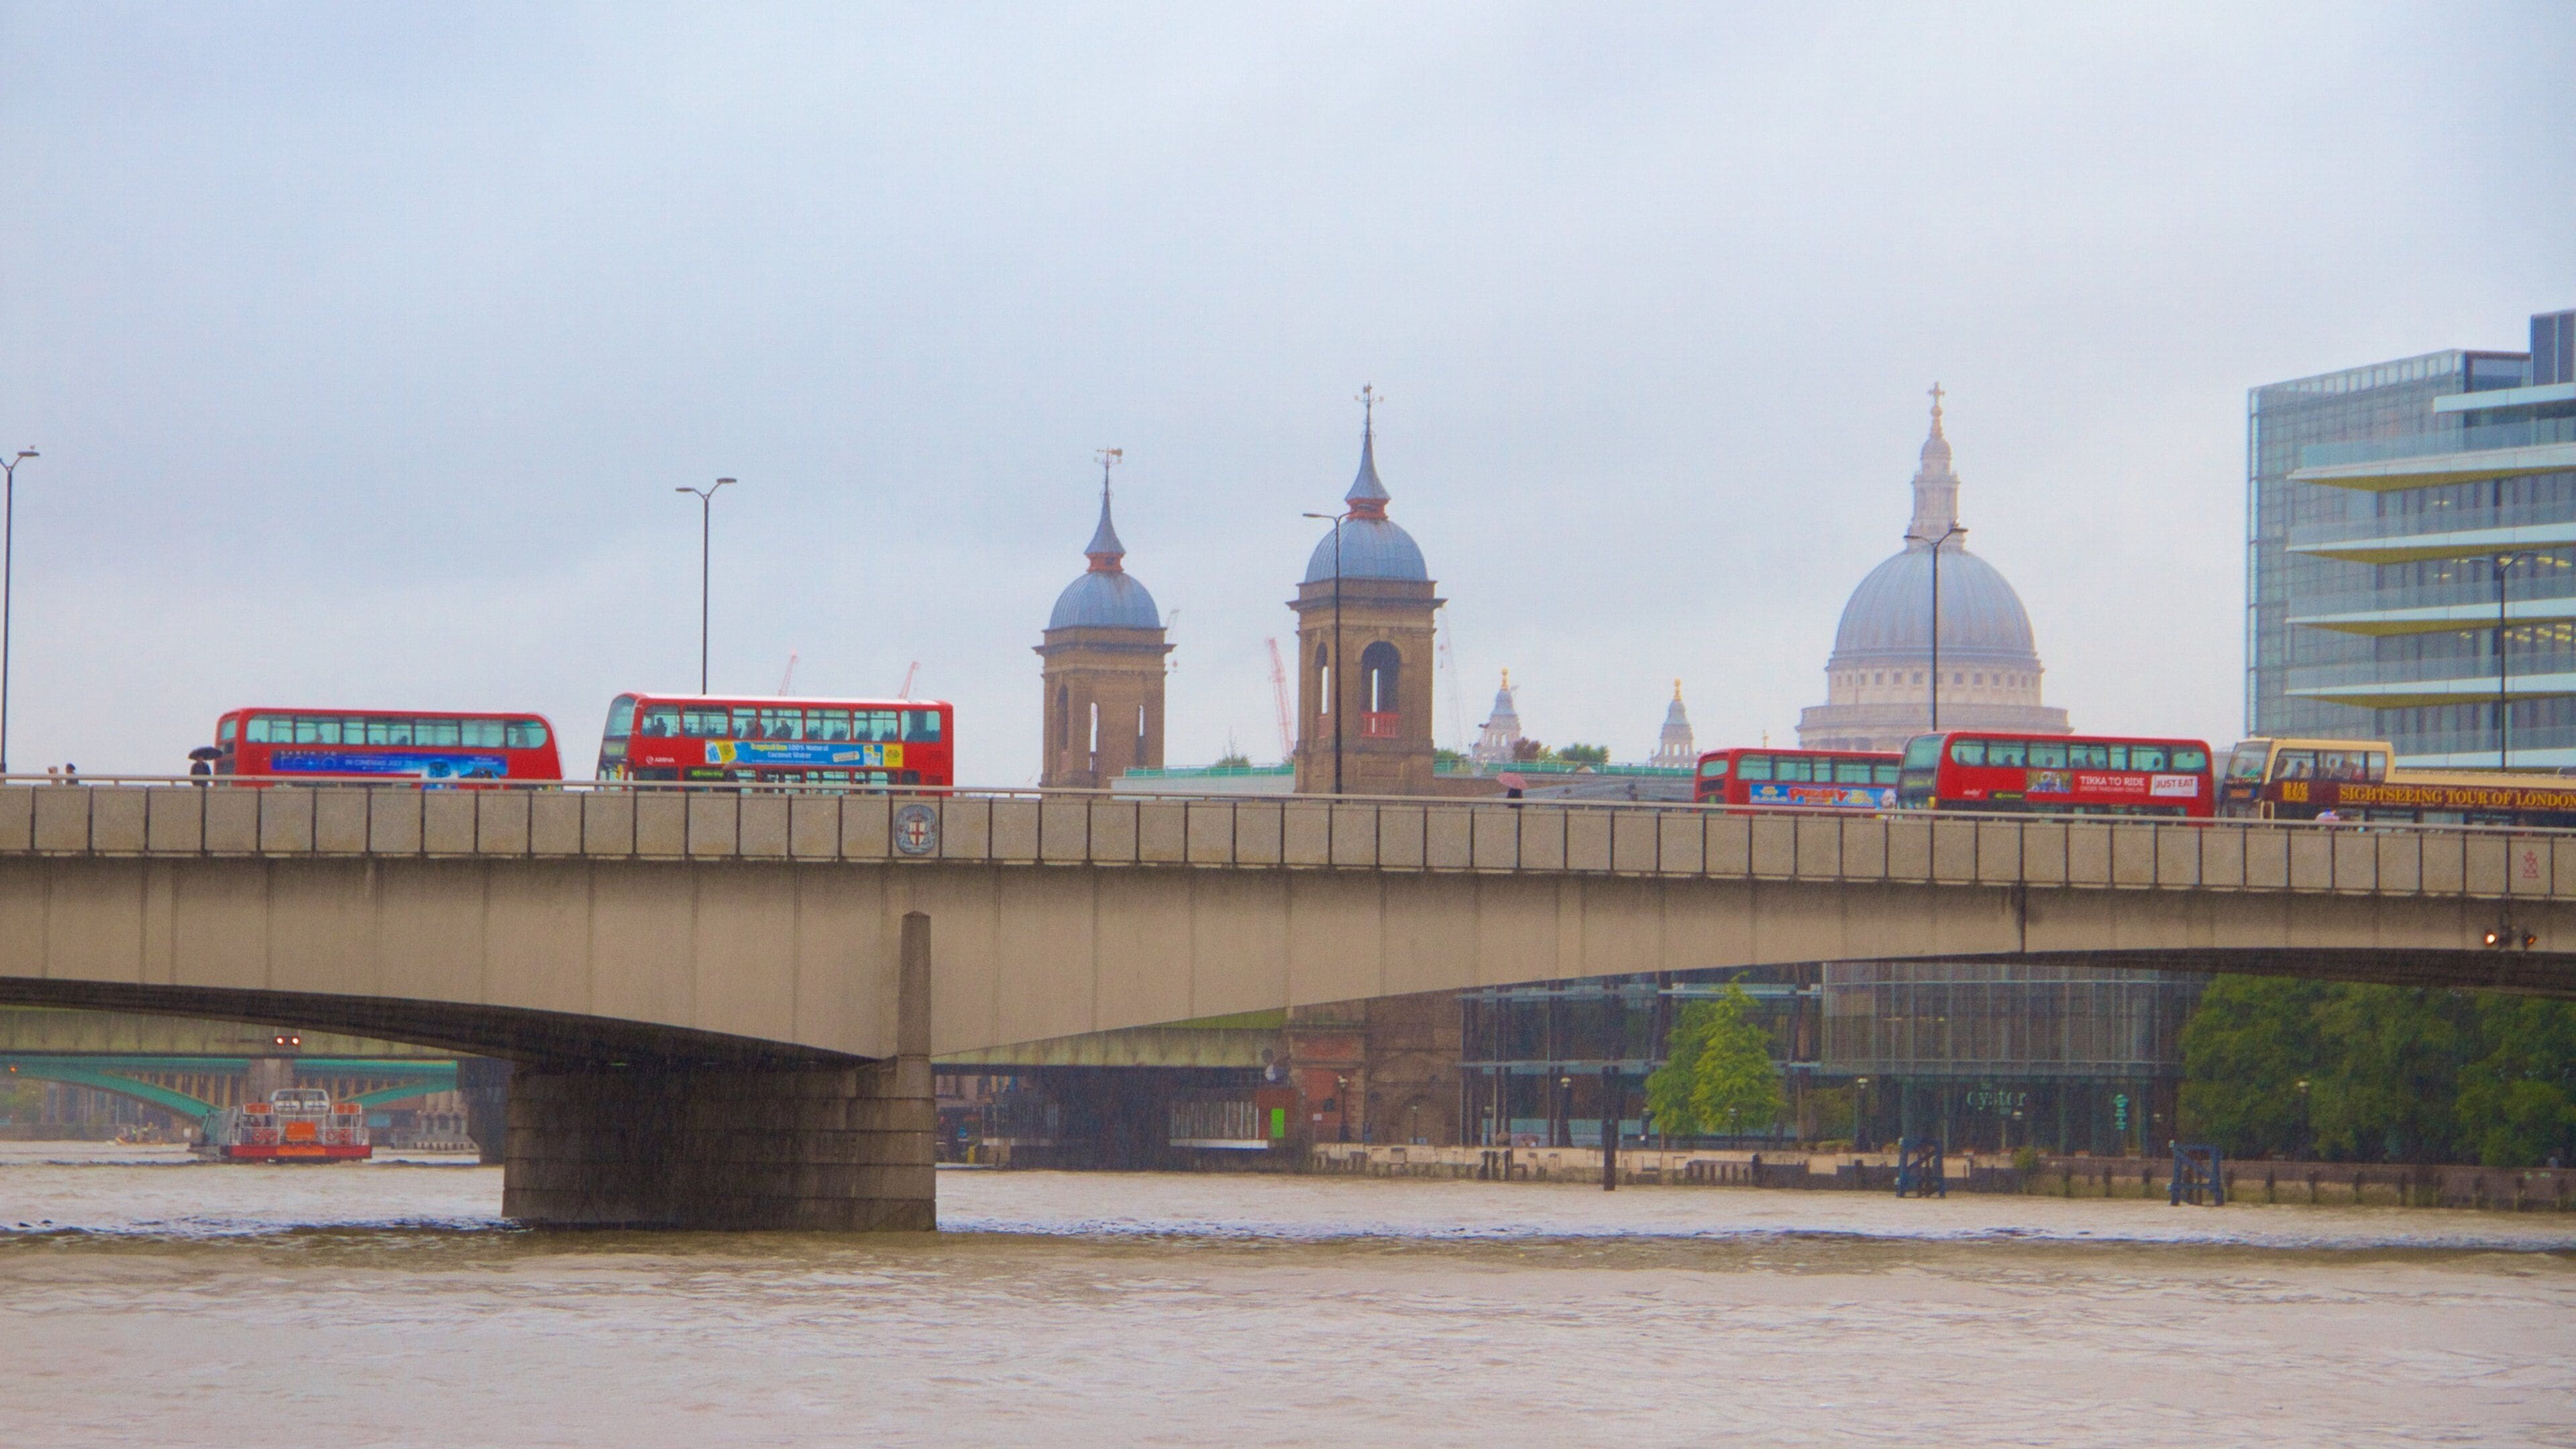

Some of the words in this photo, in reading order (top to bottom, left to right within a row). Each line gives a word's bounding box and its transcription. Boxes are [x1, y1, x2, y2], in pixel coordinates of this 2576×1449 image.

[2080, 775, 2107, 786] TIKKA
[2108, 776, 2123, 786] TO
[2124, 777, 2145, 786] RIDE
[2155, 780, 2176, 788] JUST
[2178, 779, 2194, 787] EAT
[2339, 786, 2443, 802] SIGHTSEEING
[2446, 790, 2488, 805] TOUR
[2491, 792, 2512, 805] OF
